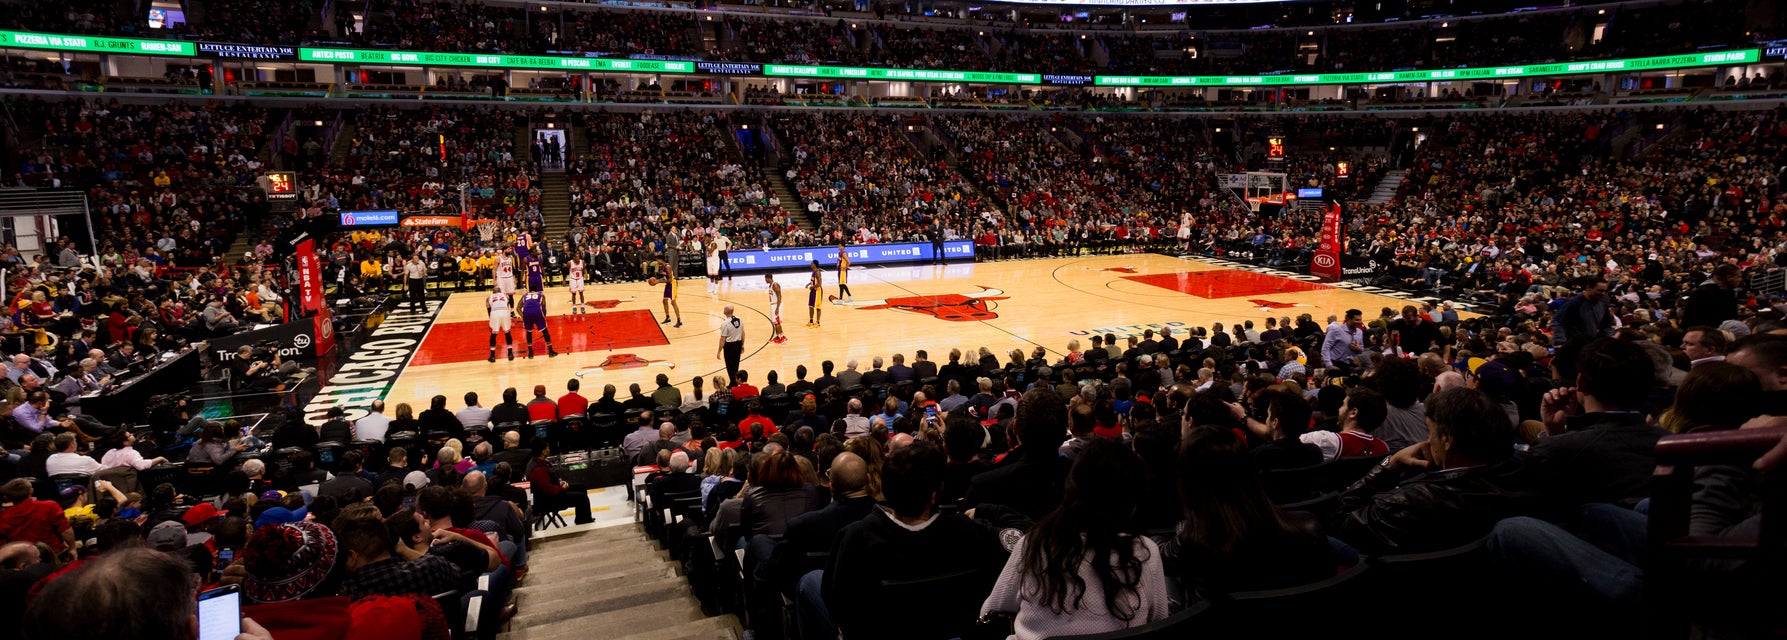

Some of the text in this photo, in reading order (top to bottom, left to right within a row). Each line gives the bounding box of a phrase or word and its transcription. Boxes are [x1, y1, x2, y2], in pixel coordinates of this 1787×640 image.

[15, 34, 48, 45] PIZZERIA
[50, 35, 63, 46] VIA
[64, 36, 87, 47] STATO
[94, 40, 135, 50] R.J. GRUNTS
[335, 51, 354, 60] POSTO
[361, 52, 384, 61] BEATRIX
[402, 54, 419, 62] BOWL
[1704, 52, 1746, 63] STUDIO PARIS
[506, 57, 519, 65] CAFE
[1631, 60, 1651, 68] STELLA
[1652, 58, 1670, 66] BARRA
[1271, 146, 1283, 156] 24
[274, 182, 288, 192] 24
[1318, 257, 1331, 265] KIA
[1342, 267, 1373, 275] TransUnion
[303, 268, 312, 302] NBA TV
